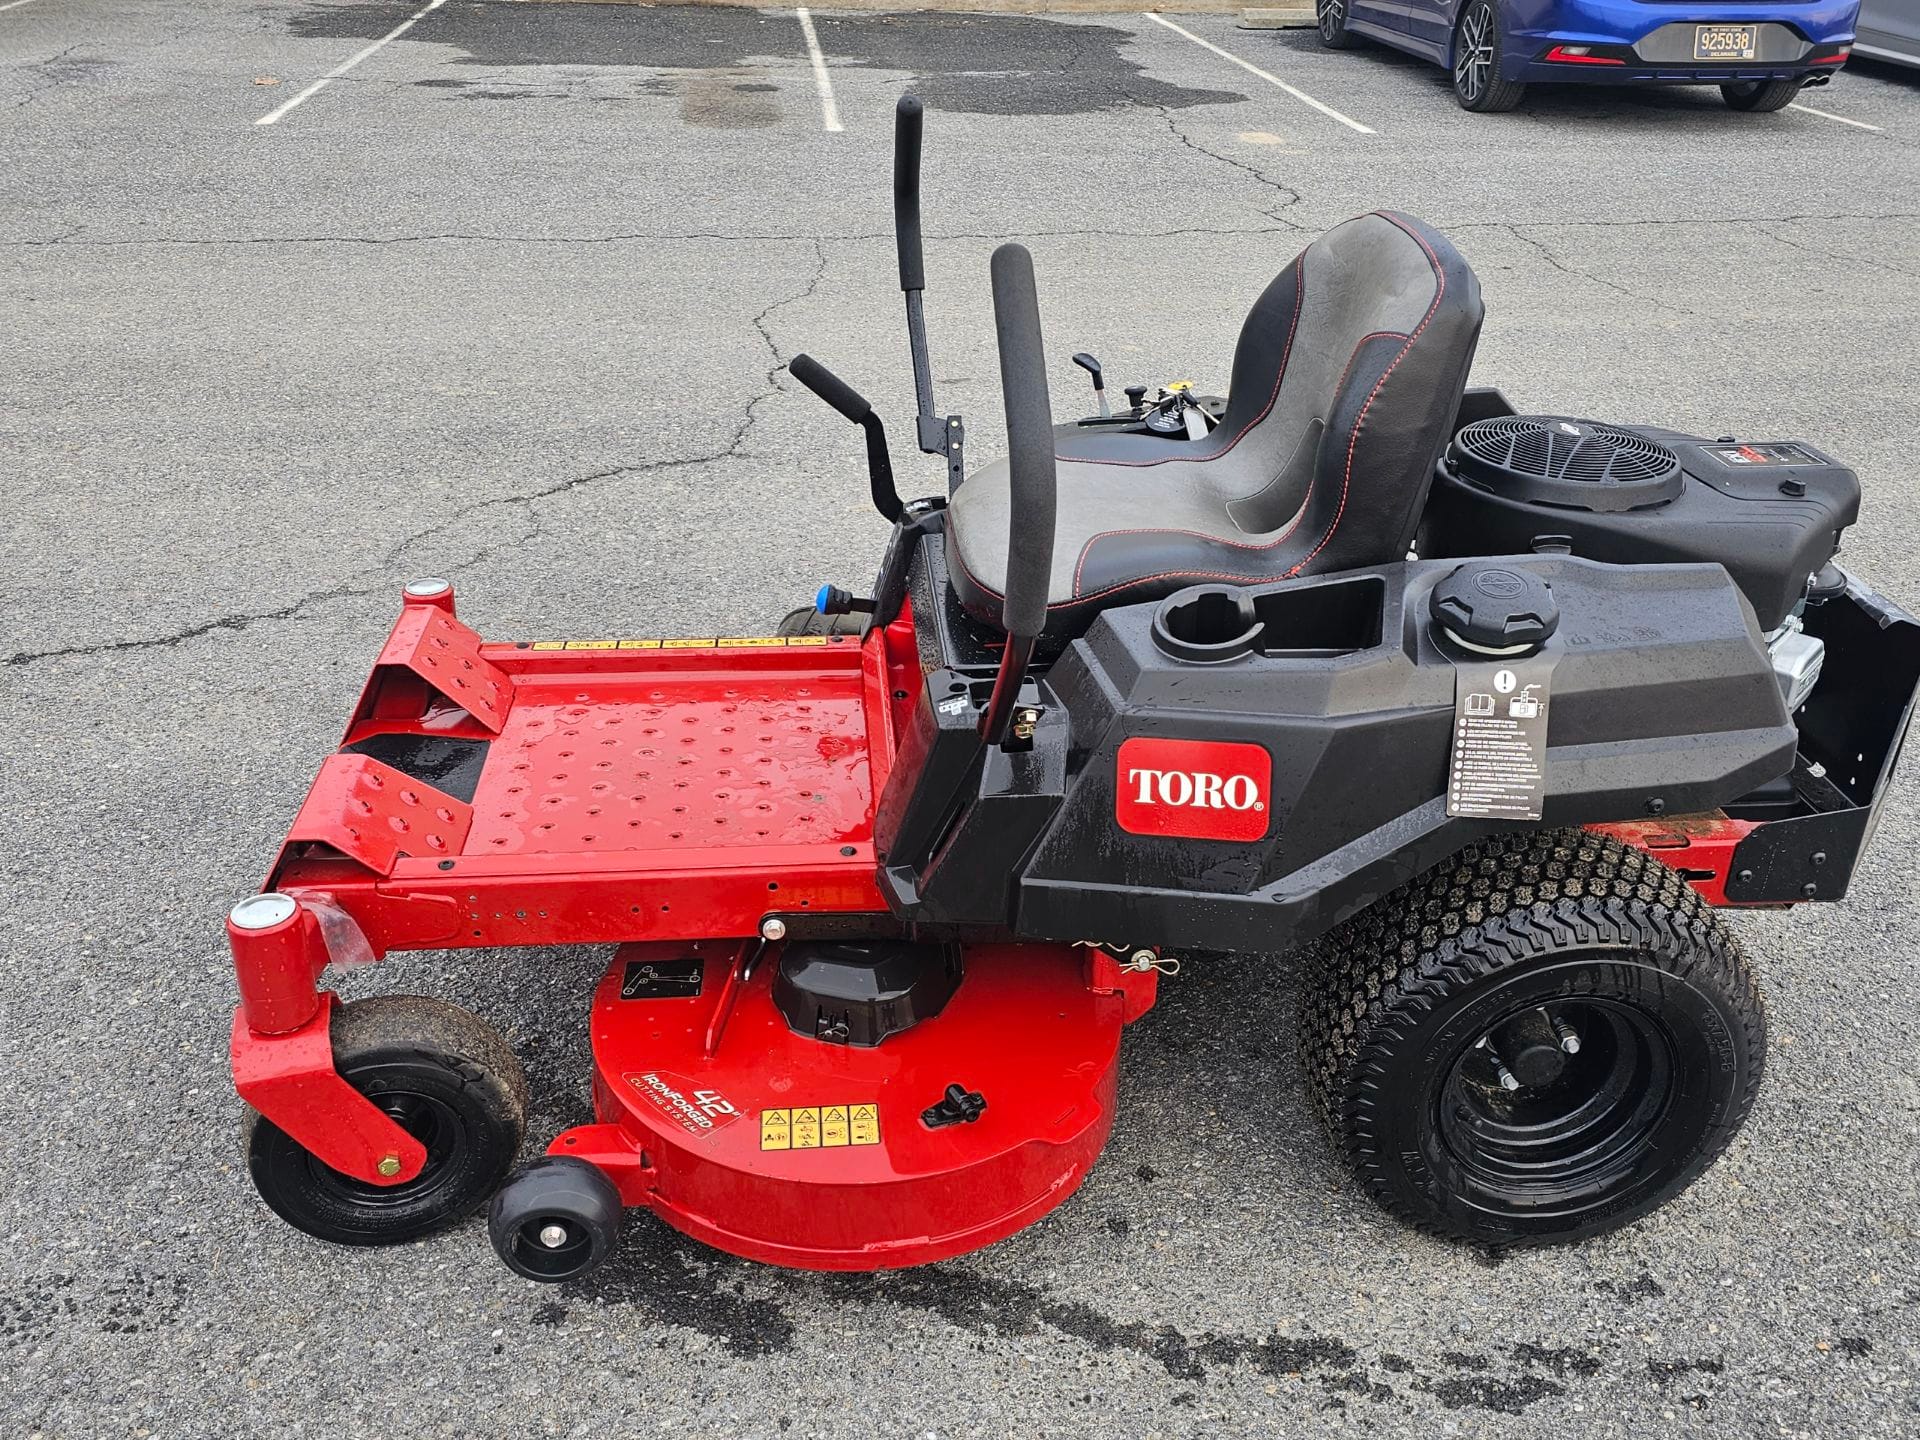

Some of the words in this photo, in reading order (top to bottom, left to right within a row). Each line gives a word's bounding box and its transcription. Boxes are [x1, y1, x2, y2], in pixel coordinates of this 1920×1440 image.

[1701, 32, 1749, 50] 925938
[1129, 769, 1258, 810] TORO
[630, 1078, 665, 1105] CUTTING
[663, 1104, 698, 1133] SYSTEM
[641, 1073, 713, 1128] IRONFORGED
[693, 1090, 741, 1118] 42"
